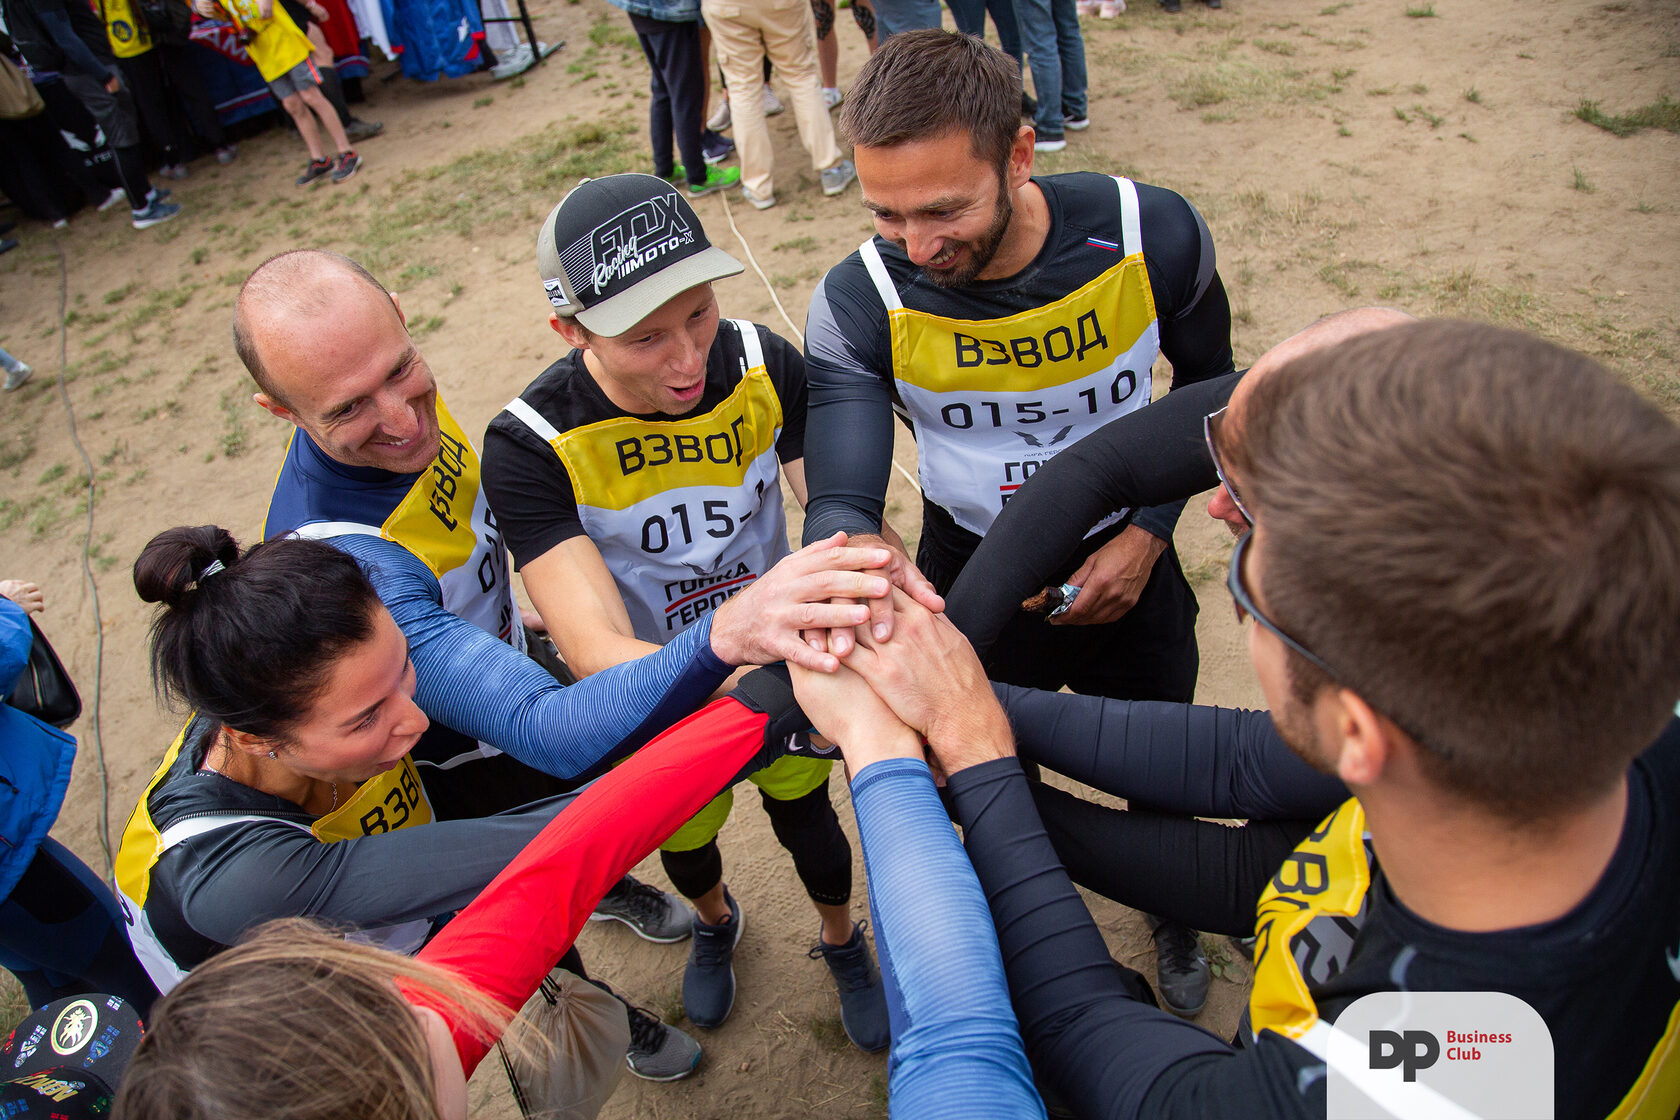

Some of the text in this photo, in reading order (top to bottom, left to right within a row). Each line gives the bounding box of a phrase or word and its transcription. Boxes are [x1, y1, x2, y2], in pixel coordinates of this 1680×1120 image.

[590, 192, 690, 272] FOX
[954, 309, 1108, 368] ВЗВОД
[941, 369, 1137, 429] 015-10
[1004, 460, 1047, 482] ГО
[666, 584, 750, 631] ГЕРО
[360, 757, 420, 836] ВЗВ
